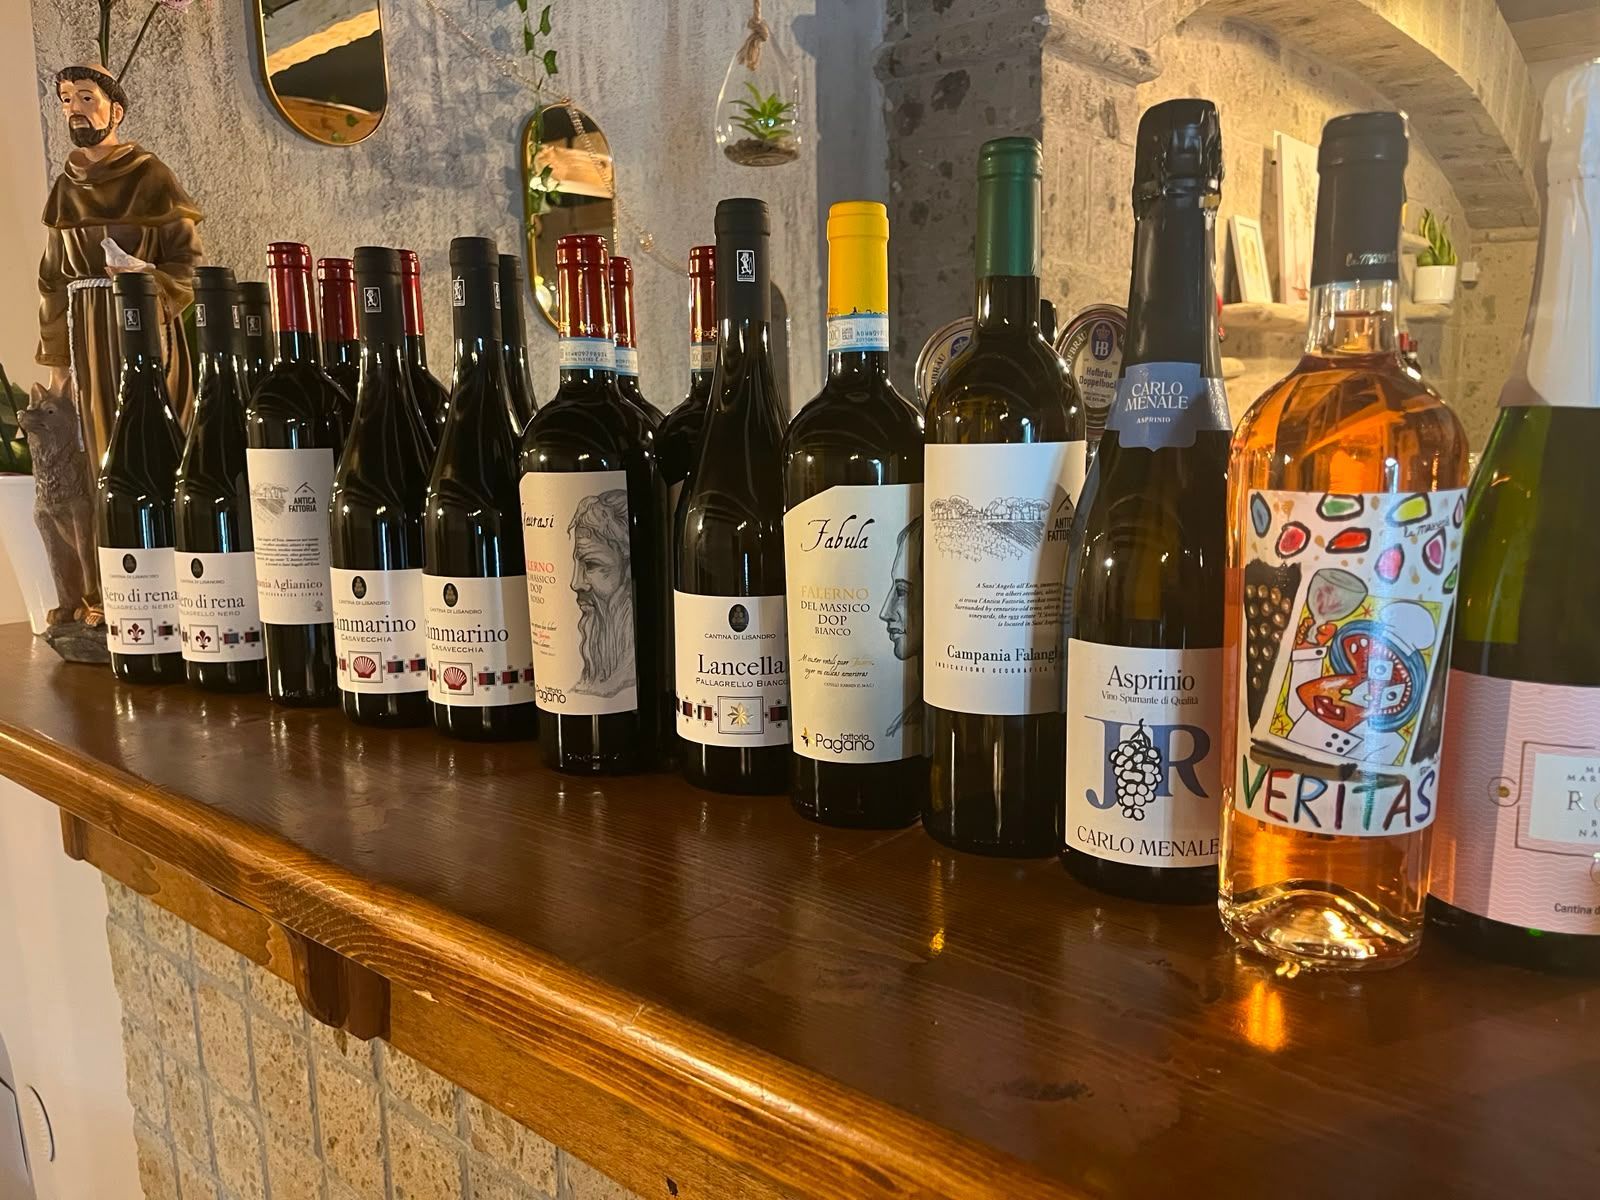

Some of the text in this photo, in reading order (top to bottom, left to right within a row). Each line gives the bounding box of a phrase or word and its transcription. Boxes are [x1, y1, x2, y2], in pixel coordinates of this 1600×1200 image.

[1094, 340, 1109, 356] HB
[1132, 381, 1183, 397] CARLO
[1125, 396, 1189, 411] MENALE
[1137, 416, 1171, 424] ASPRINIO
[294, 497, 316, 505] ANTICA
[288, 505, 318, 513] FATTORIA
[800, 514, 876, 552] Fabula
[527, 560, 555, 574] LERNO
[274, 579, 323, 592] Aglianico
[128, 588, 140, 602] di
[145, 590, 178, 602] rena
[800, 585, 869, 601] FALERNO
[196, 594, 207, 609] di
[211, 597, 245, 609] rena
[800, 600, 870, 613] DEL MASSICO
[818, 614, 848, 626] DOP
[815, 627, 851, 636] BIANCO
[431, 643, 484, 653] CASAVECCHIA
[947, 644, 1011, 665] Campania
[697, 653, 785, 676] Lancella
[696, 677, 754, 688] PALLAGRELLO
[1107, 665, 1196, 695] Asprinio
[1101, 690, 1200, 706] Vino Spumante di Qualità
[815, 732, 876, 754] Pagano
[840, 732, 870, 741] fattoria
[1242, 753, 1436, 832] VERITAS
[1076, 825, 1219, 858] CARLO MENALE
[1554, 902, 1592, 915] Cantina
